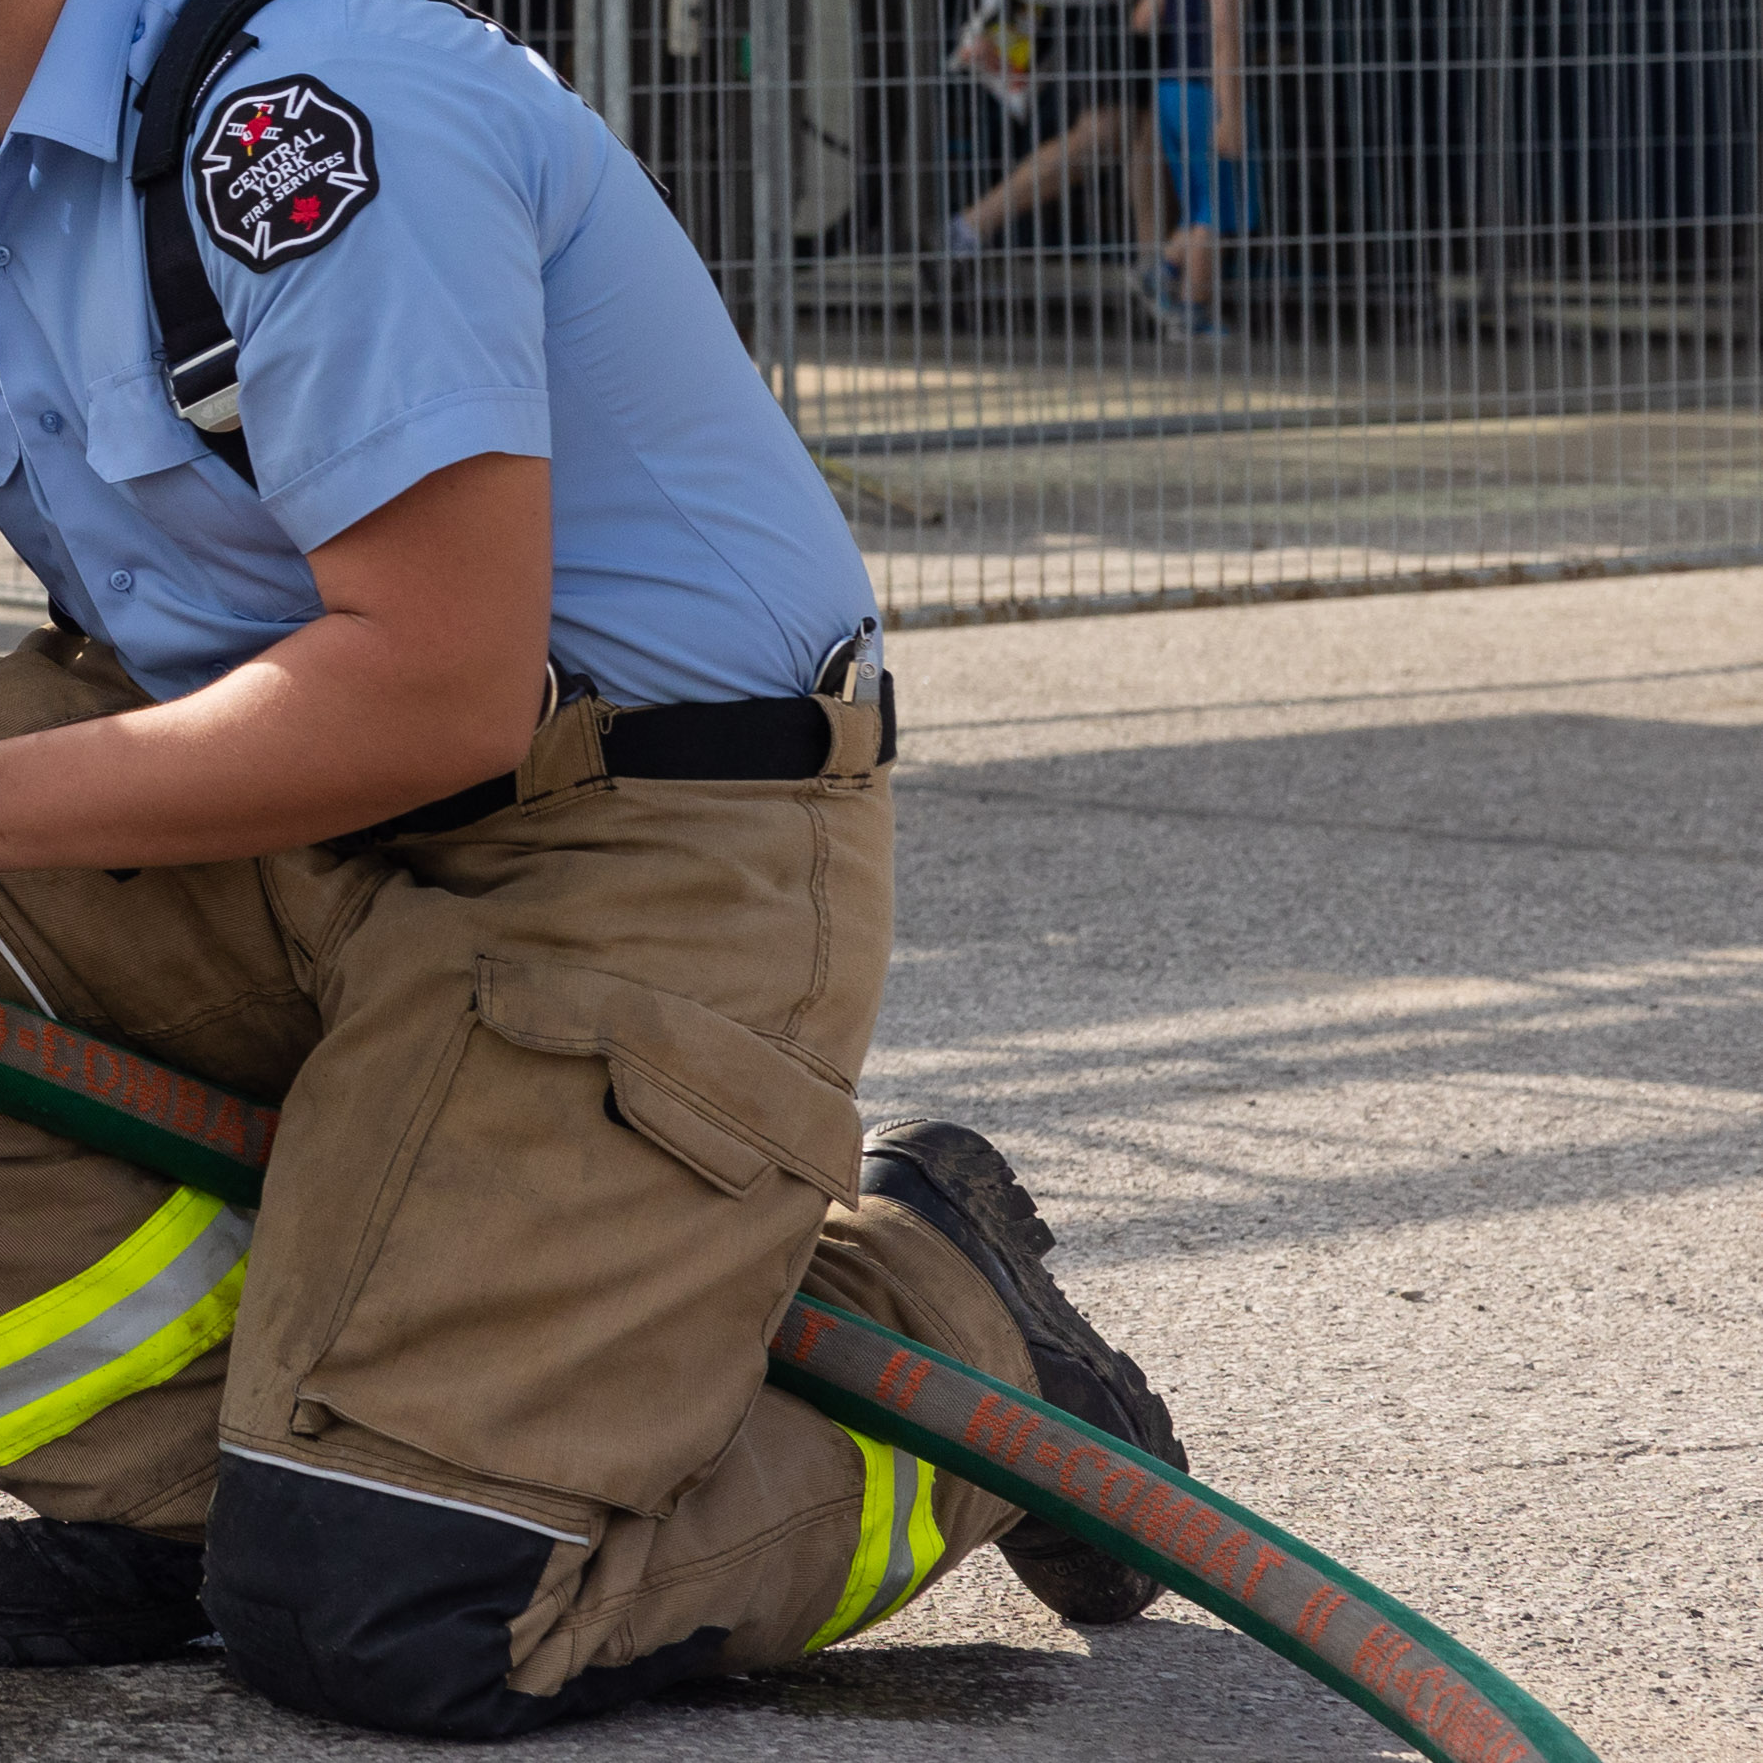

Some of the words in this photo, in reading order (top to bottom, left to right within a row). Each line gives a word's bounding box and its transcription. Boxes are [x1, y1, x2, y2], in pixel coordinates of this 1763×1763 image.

[228, 128, 325, 200] CENTRAL
[241, 197, 274, 230] FIRE
[274, 151, 346, 203] SERVICES
[249, 150, 312, 199] YORK
[966, 1394, 1287, 1601] HI-COMBAT
